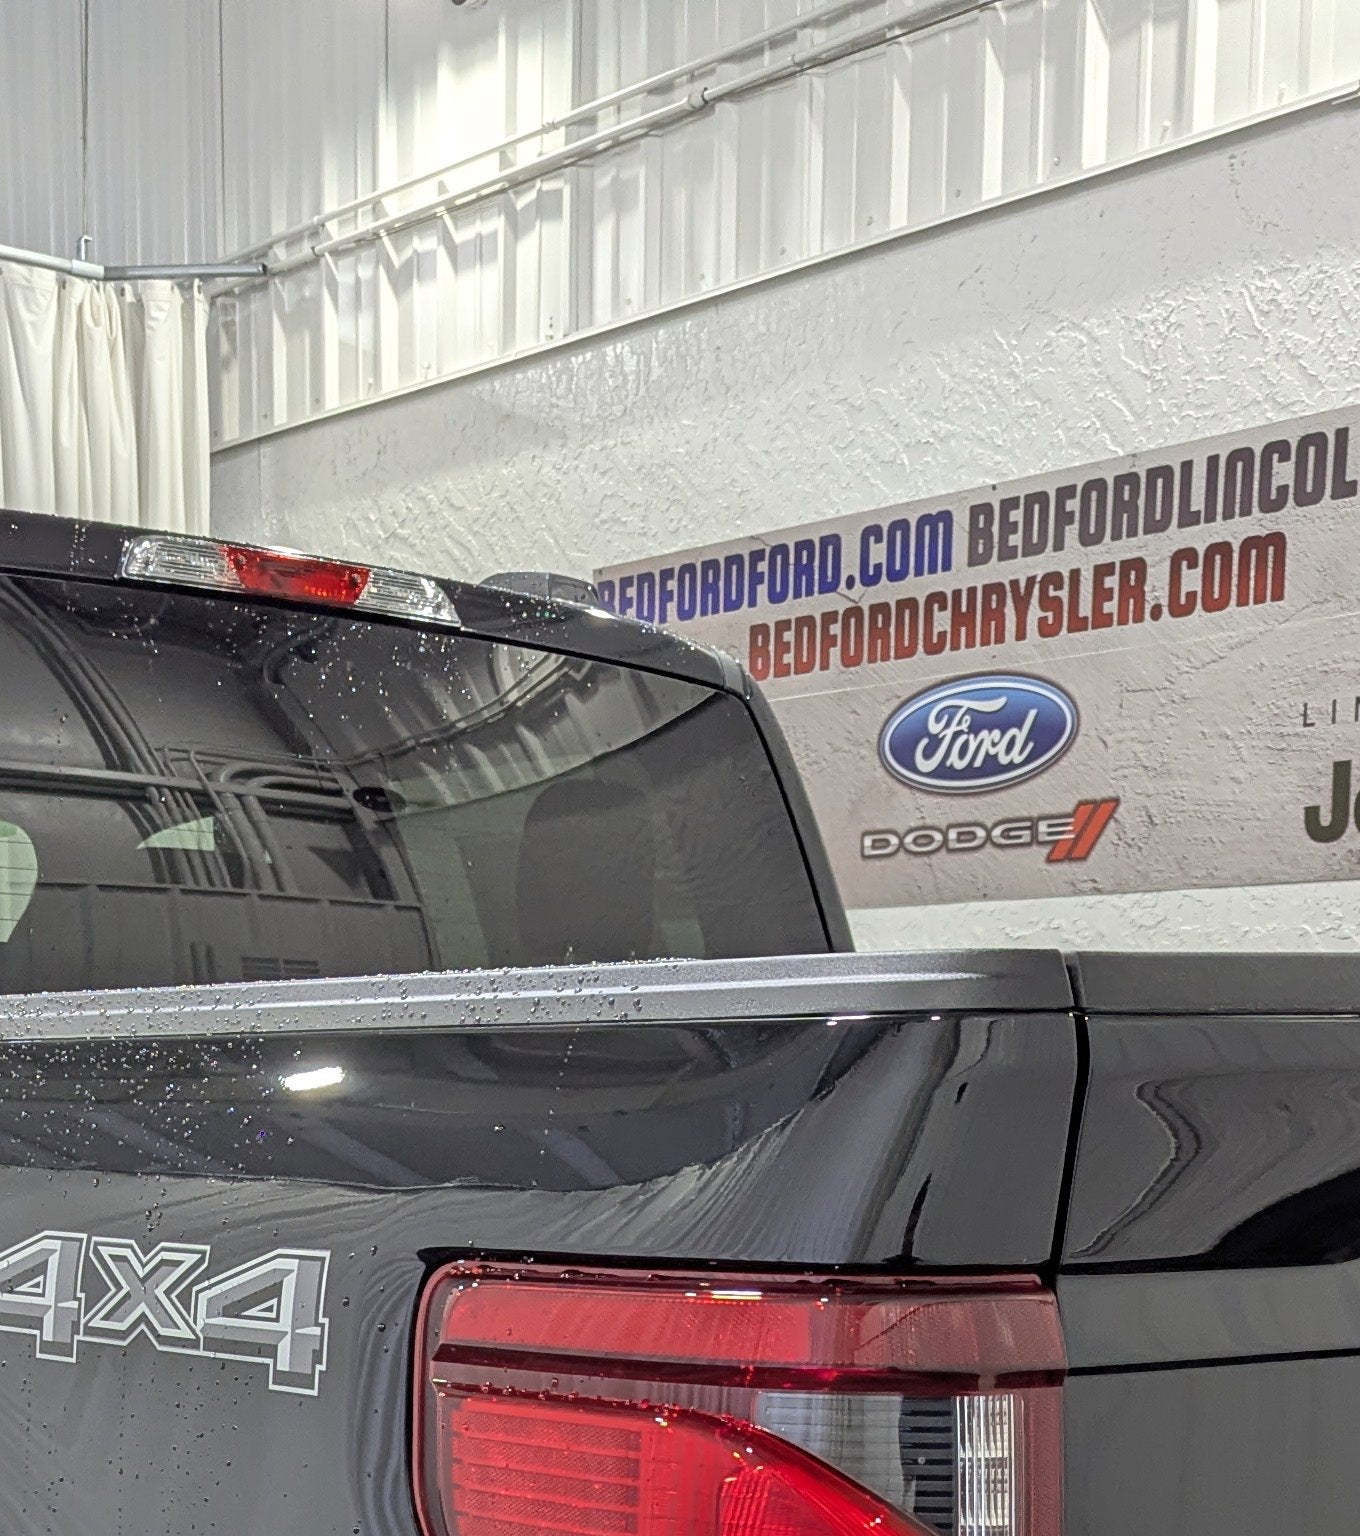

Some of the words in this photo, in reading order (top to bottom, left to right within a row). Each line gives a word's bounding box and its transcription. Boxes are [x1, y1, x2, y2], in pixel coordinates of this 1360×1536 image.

[749, 531, 1287, 682] BEDFORDCHRYSLER.COM
[914, 696, 1038, 773] Ford
[861, 817, 1074, 857] DODGE
